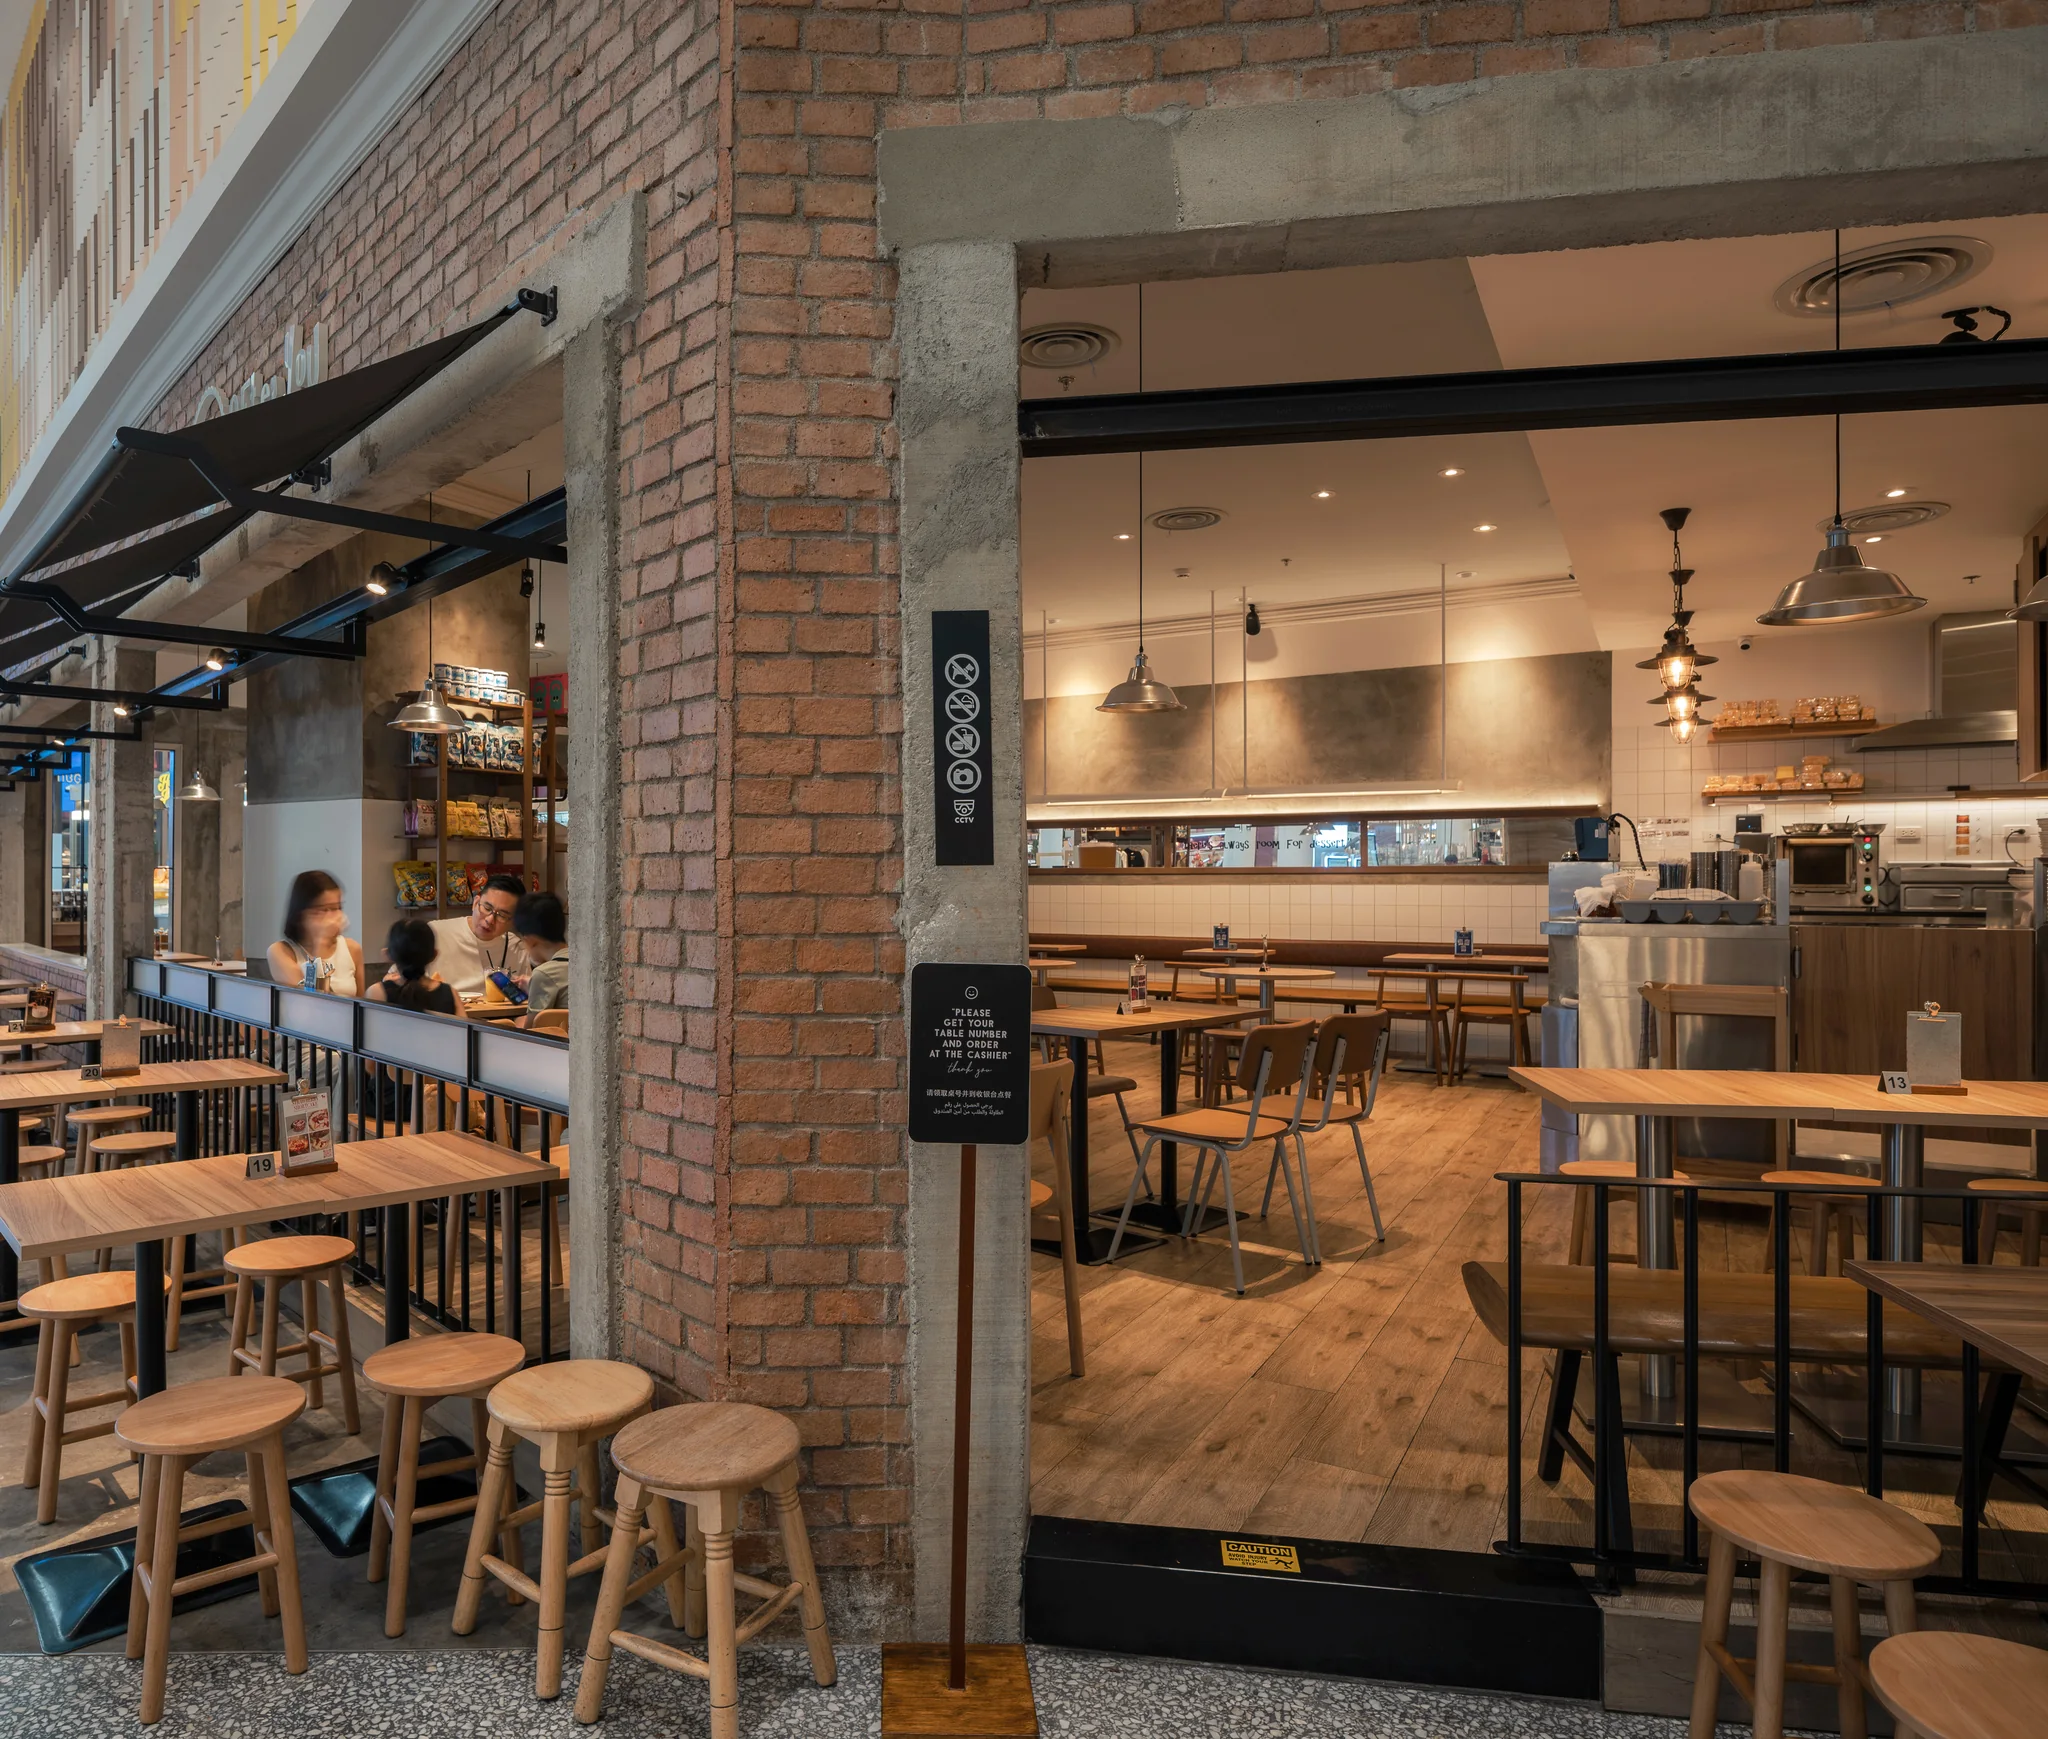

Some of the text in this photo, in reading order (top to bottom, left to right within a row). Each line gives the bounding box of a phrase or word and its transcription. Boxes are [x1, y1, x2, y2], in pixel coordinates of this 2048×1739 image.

[954, 816, 975, 824] CCTV
[943, 1018, 994, 1028] GET YOUR
[934, 1028, 1008, 1039] TABLE NUMBER
[942, 1039, 999, 1049] AND ORDER
[929, 1049, 940, 1058] AT
[944, 1050, 963, 1059] THE
[85, 1068, 98, 1077] 20
[947, 1060, 992, 1078] thank you
[1888, 1076, 1907, 1089] 13
[253, 1158, 272, 1173] 19
[1228, 1543, 1290, 1556] CAUTION
